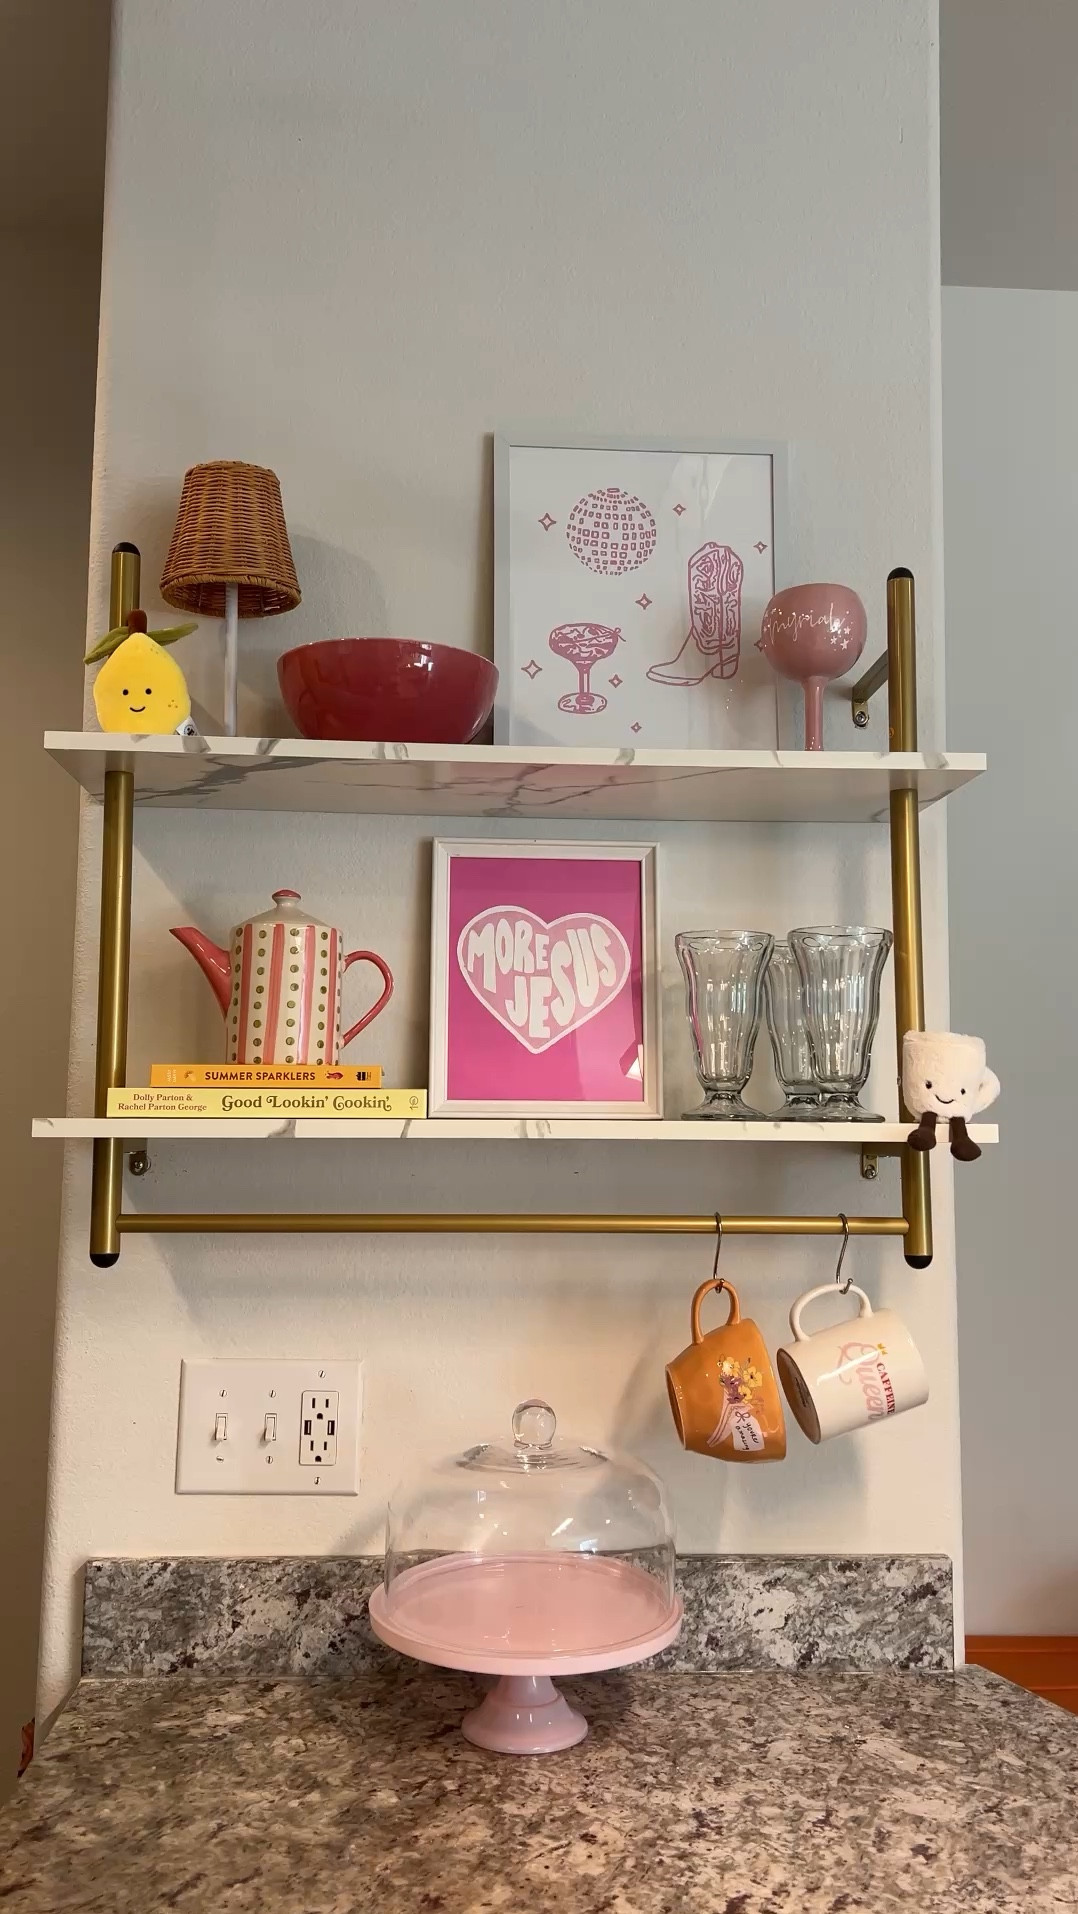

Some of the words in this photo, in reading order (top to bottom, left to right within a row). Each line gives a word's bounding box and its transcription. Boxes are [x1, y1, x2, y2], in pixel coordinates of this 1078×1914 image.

[467, 918, 550, 994] MORE
[504, 923, 617, 1039] JESUS
[205, 1071, 253, 1081] SUMMER
[255, 1072, 316, 1082] SPARKLERS
[118, 1103, 146, 1111] Rachel
[148, 1103, 176, 1111] Parton
[178, 1103, 207, 1112] George
[133, 1093, 155, 1102] Dolly
[156, 1093, 184, 1101] Parton
[221, 1095, 262, 1112] Good
[266, 1095, 329, 1108] Lookin'
[332, 1095, 393, 1112] Cookin'
[837, 1342, 885, 1420] Queen
[876, 1362, 896, 1415] CAFFEINE
